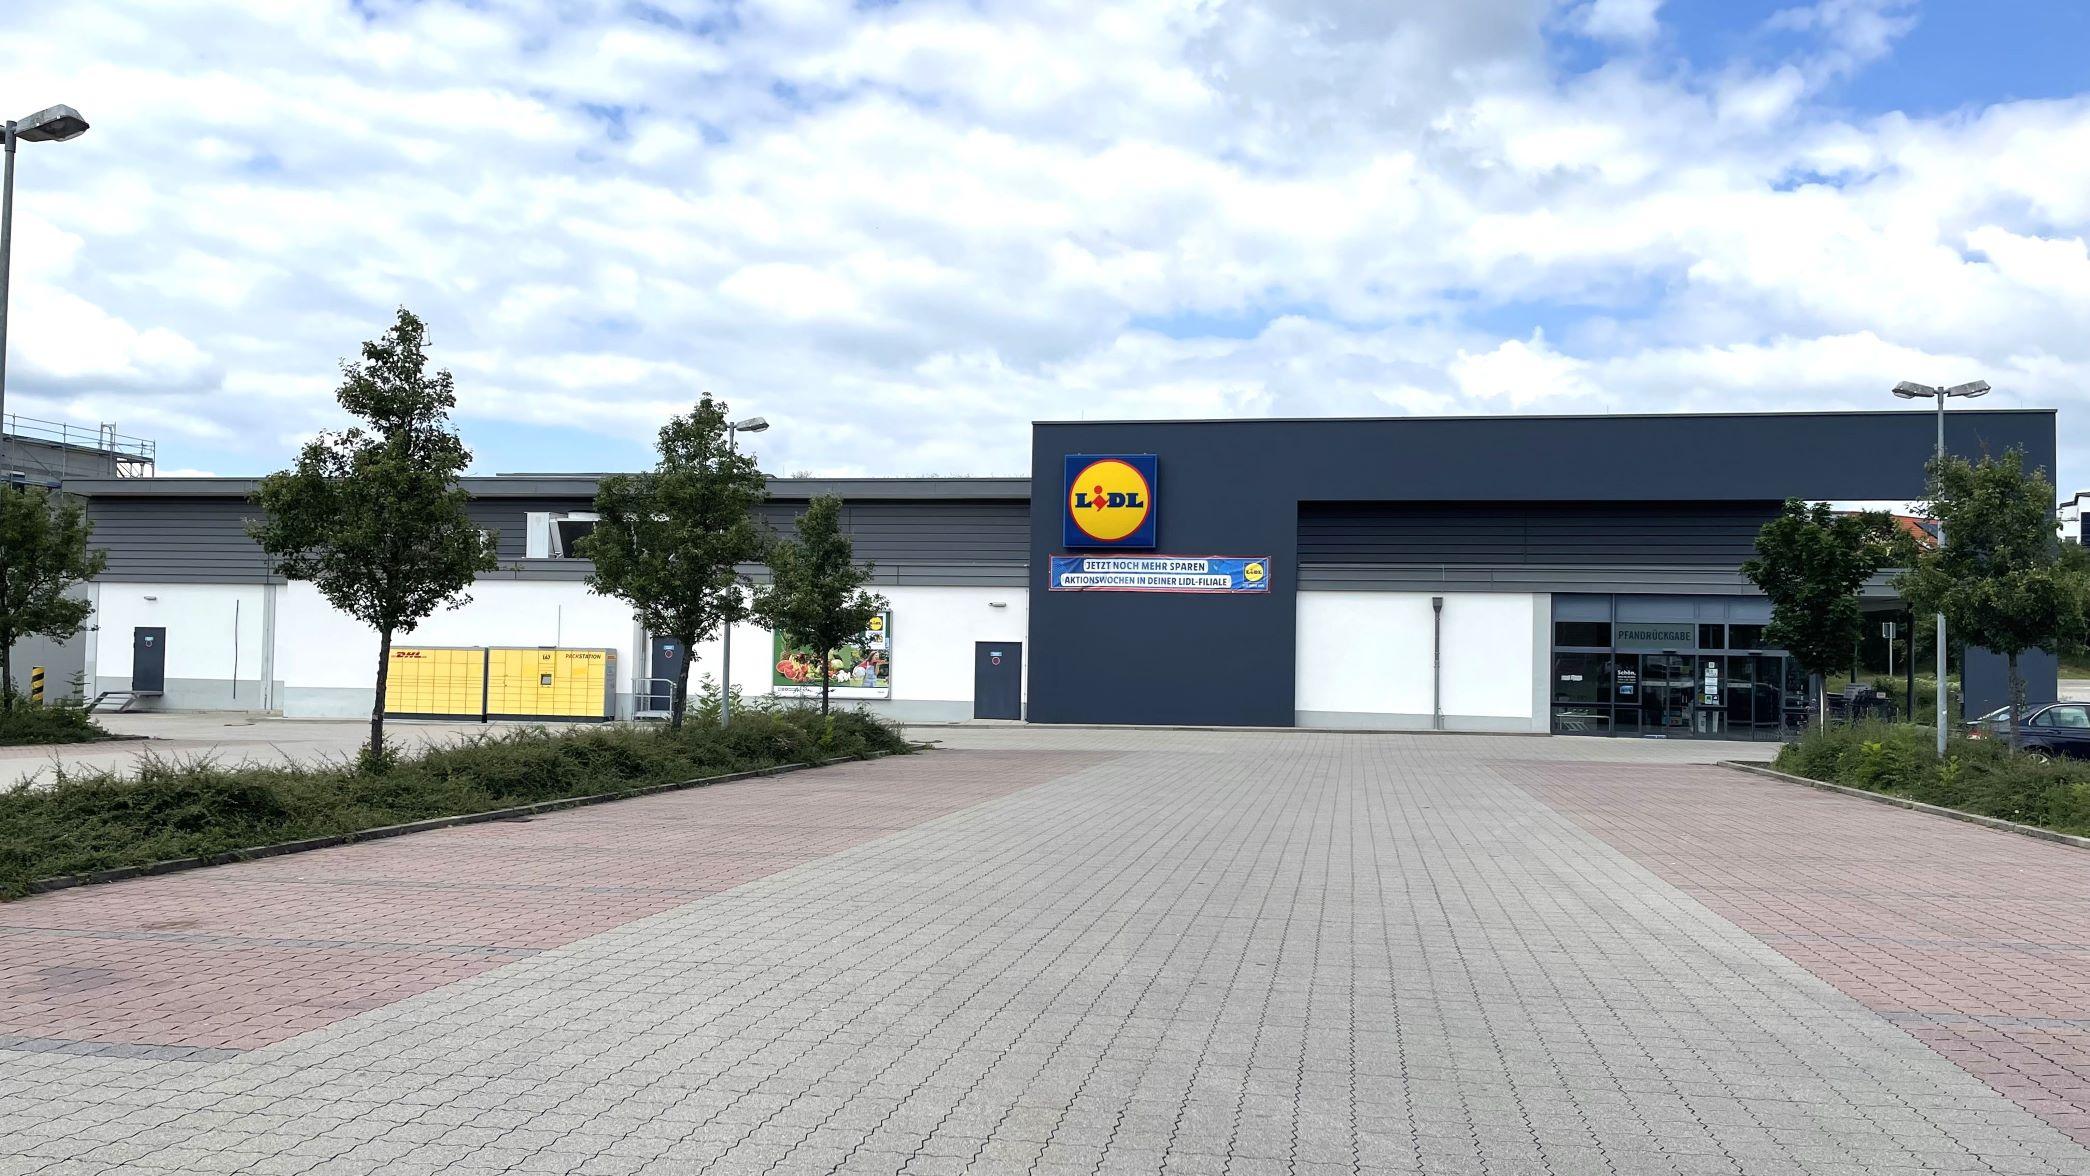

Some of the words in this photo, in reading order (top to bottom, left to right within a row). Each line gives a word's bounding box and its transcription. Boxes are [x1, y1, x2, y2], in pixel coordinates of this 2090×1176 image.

[1086, 561, 1111, 570] JETZT
[1113, 561, 1139, 570] NOCH
[1141, 562, 1168, 571] MEHR
[1170, 562, 1205, 571] SPAREN
[1065, 576, 1135, 585] AKTIONSWOCHEN
[1137, 577, 1146, 585] IN
[1147, 577, 1177, 585] DEINER
[1178, 577, 1228, 586] LIDL-FILIALE
[1618, 628, 1691, 641] PFANDRÜCKGABE
[396, 651, 422, 659] DHL
